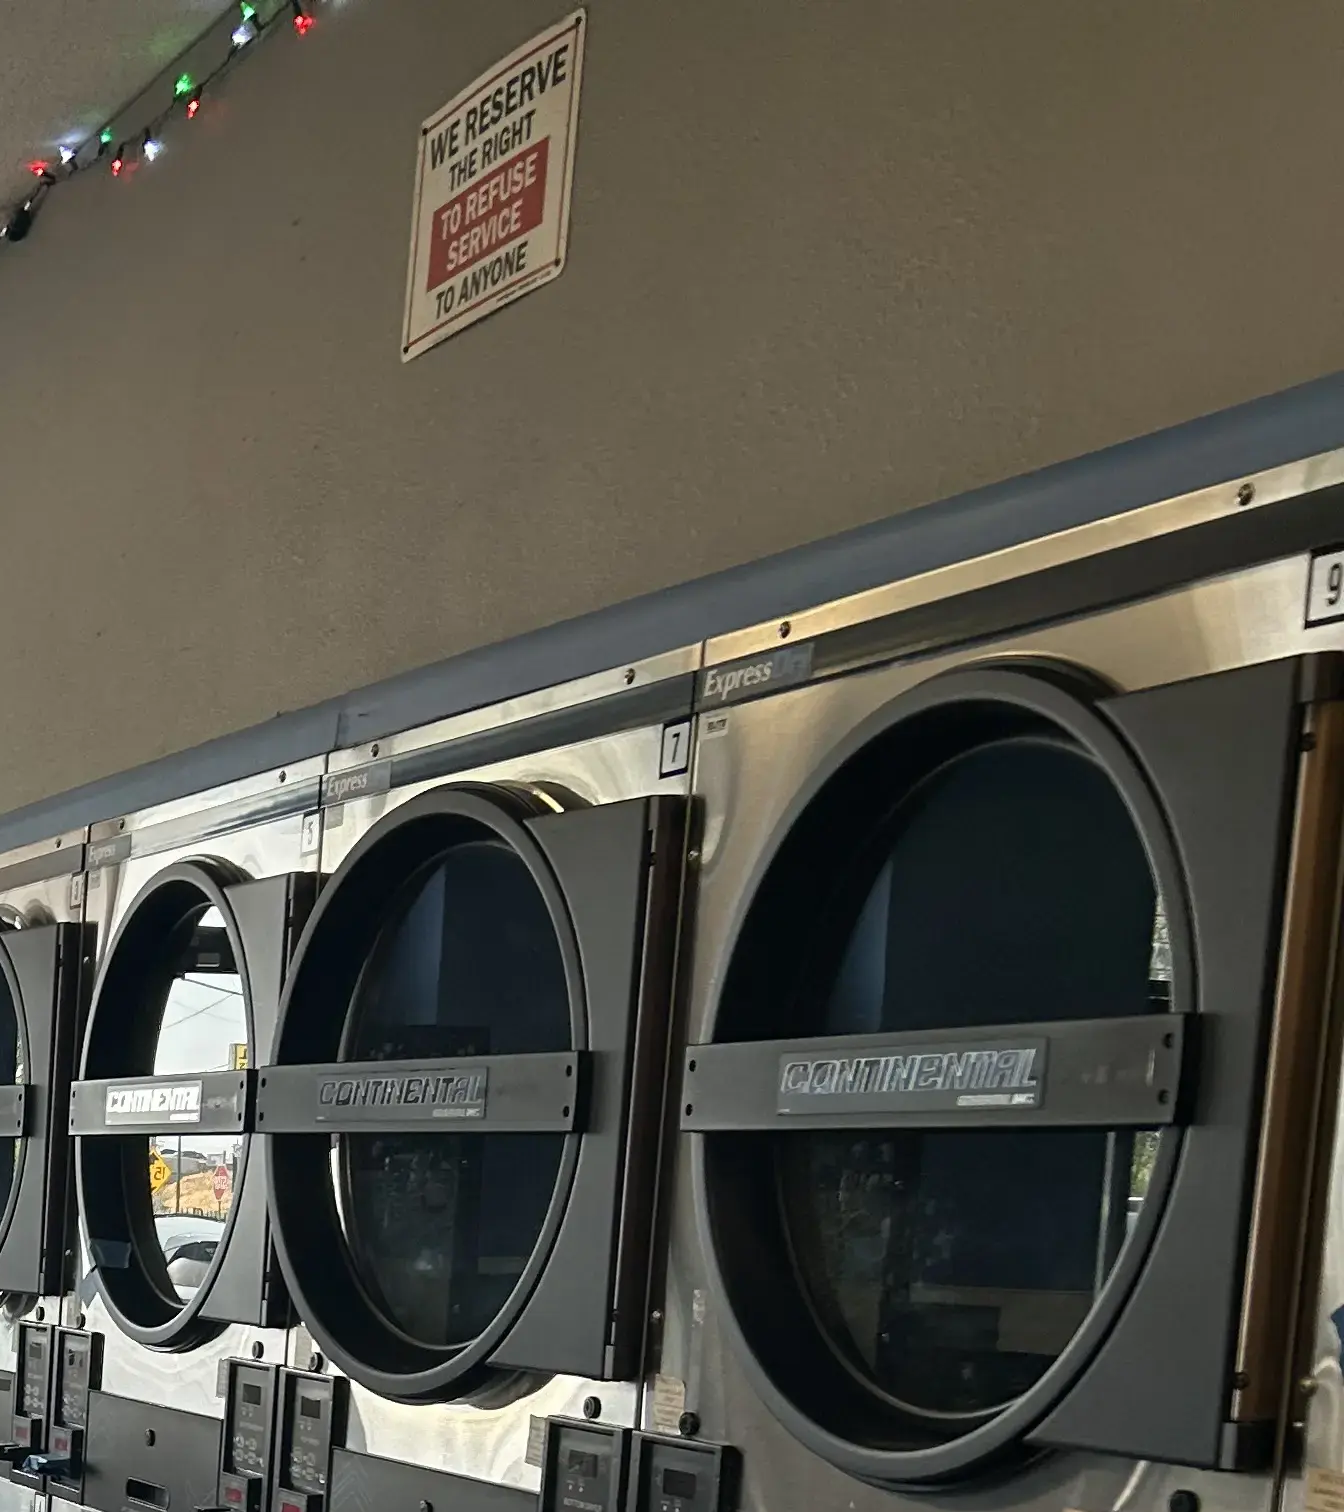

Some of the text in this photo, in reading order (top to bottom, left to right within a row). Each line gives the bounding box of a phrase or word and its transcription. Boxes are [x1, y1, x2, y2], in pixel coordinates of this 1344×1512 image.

[431, 44, 569, 170] WE RESERVE
[448, 109, 536, 193] THE RIGHT
[440, 152, 538, 240] TO REFUSE
[446, 198, 523, 271] SERVICE
[435, 288, 455, 319] TO
[457, 241, 528, 308] ANYONE
[1325, 562, 1343, 607] 9
[671, 732, 681, 763] 7
[320, 1076, 482, 1106] CONTINENTAL
[781, 1048, 1037, 1093] CONTINENTAL
